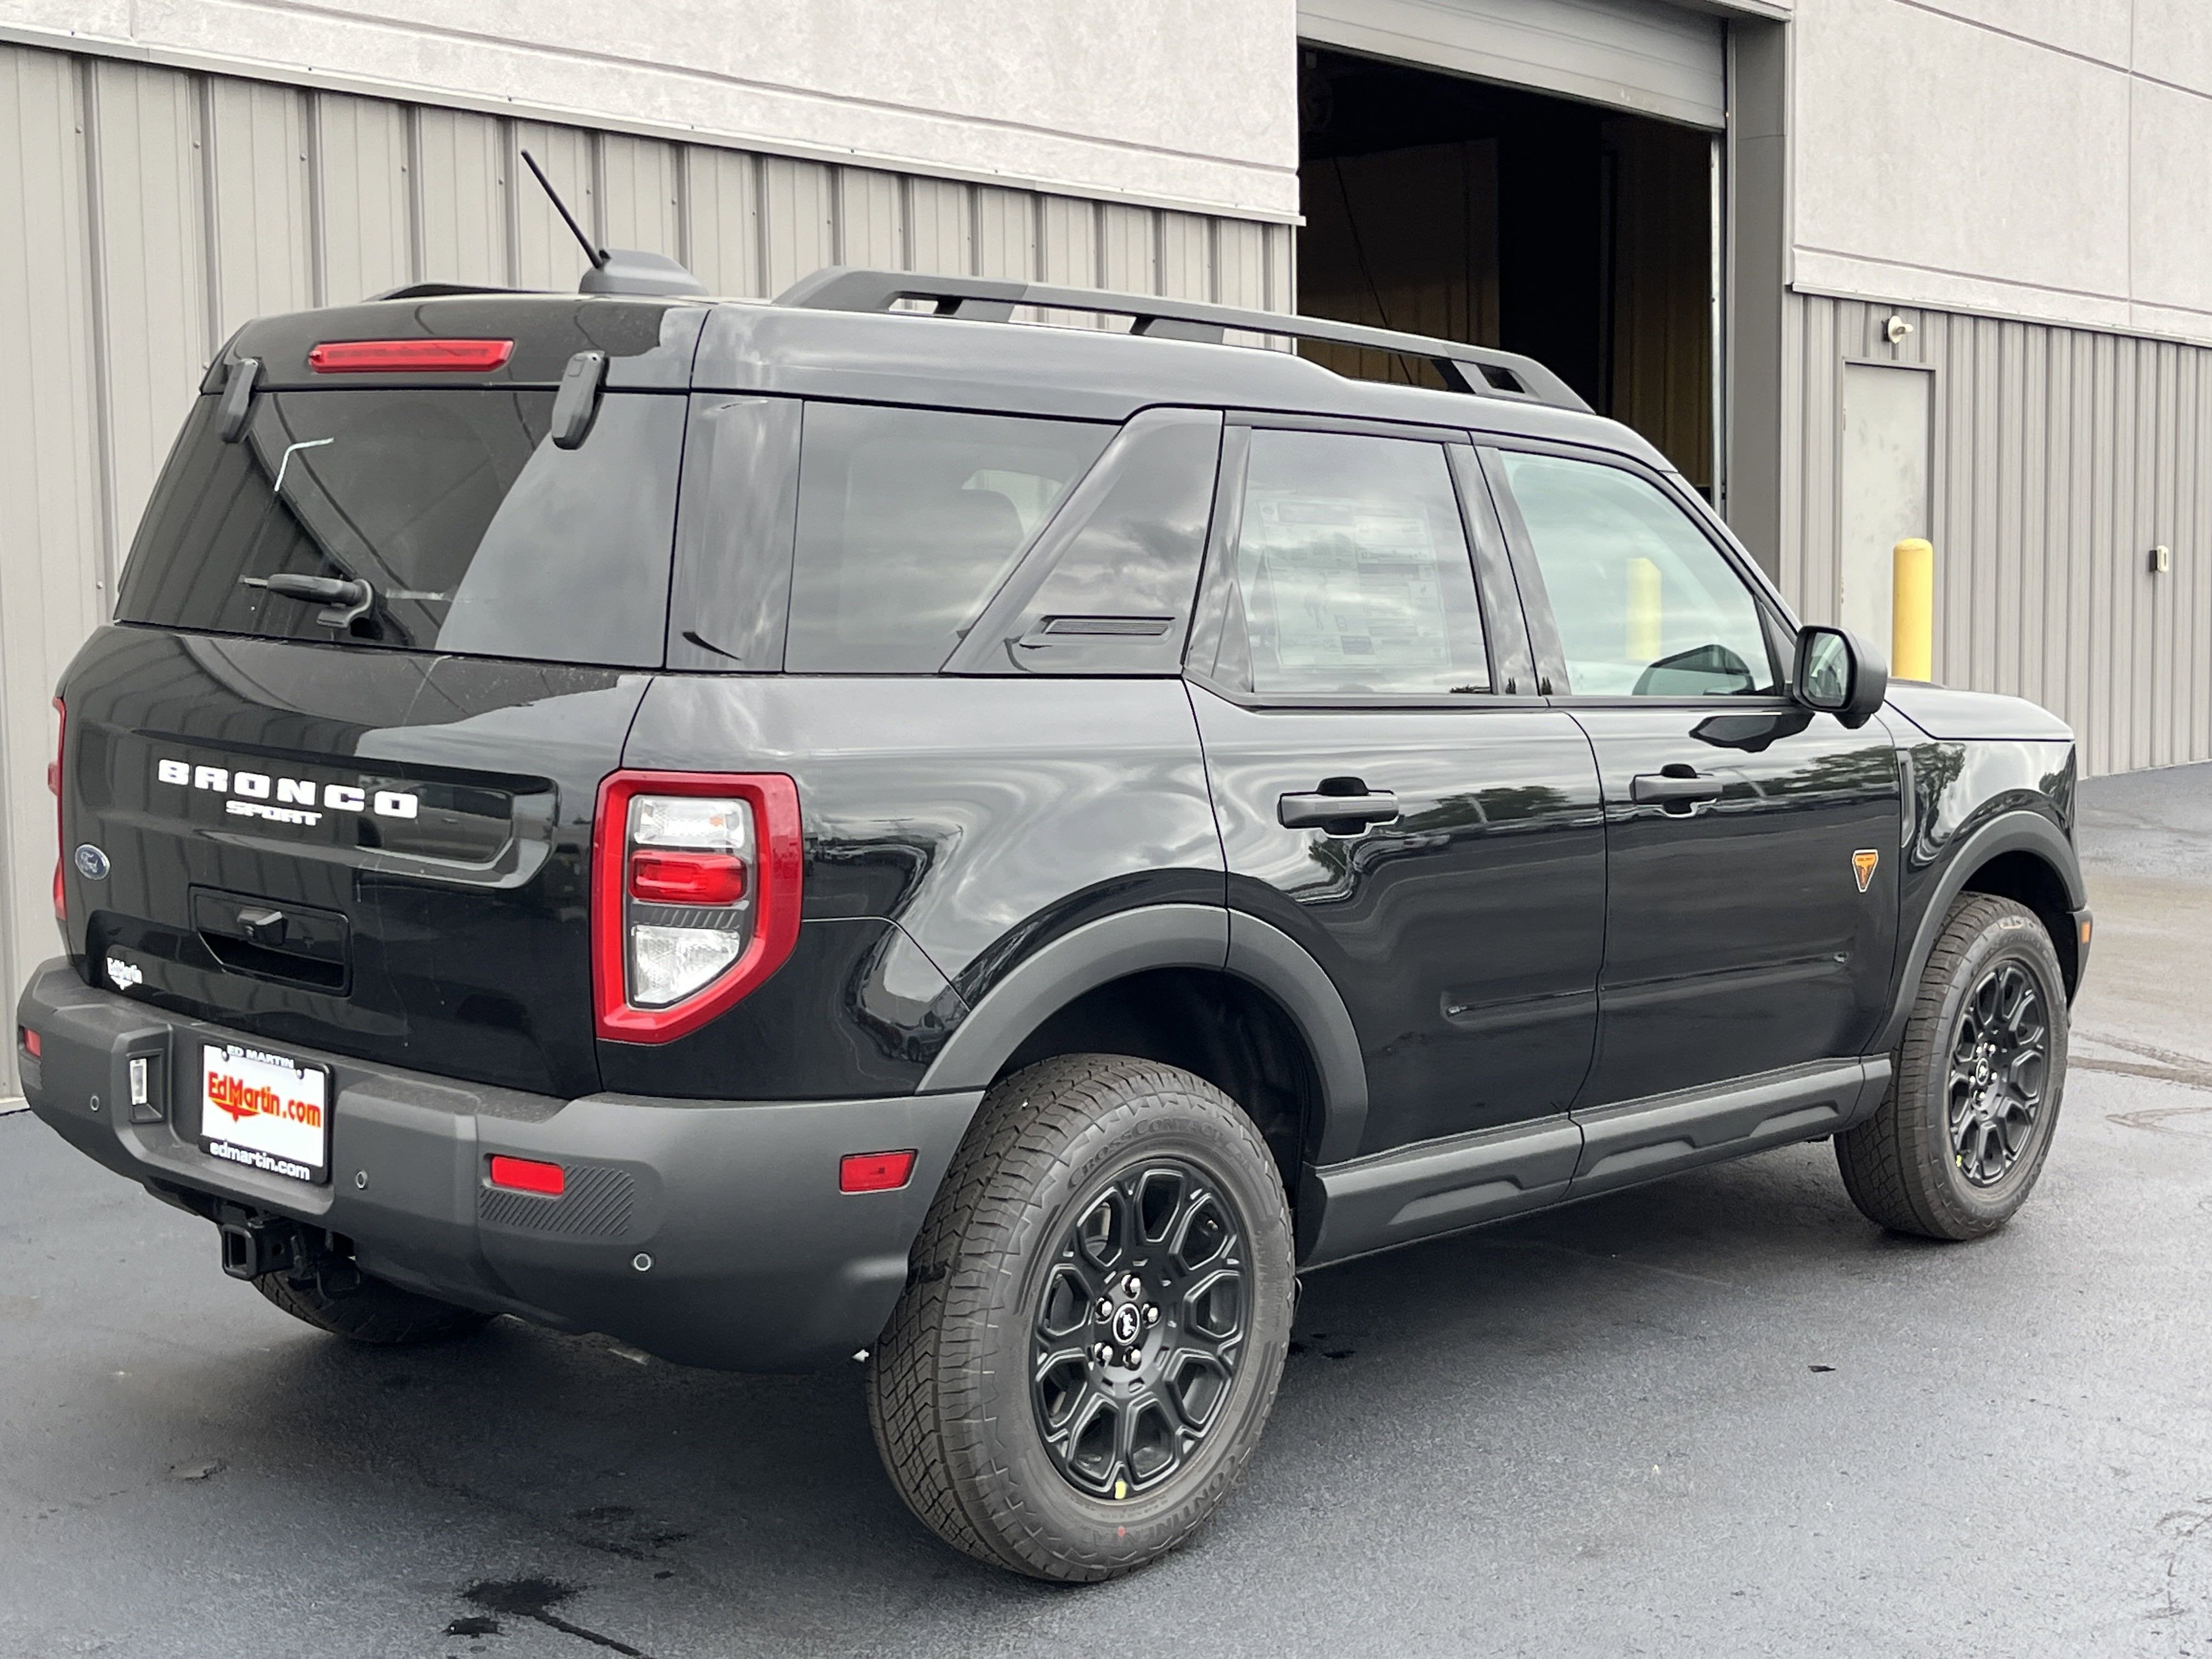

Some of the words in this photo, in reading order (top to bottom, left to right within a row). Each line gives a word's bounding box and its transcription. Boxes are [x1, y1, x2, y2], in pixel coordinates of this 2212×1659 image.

[158, 759, 417, 819] BRONCO
[225, 800, 322, 826] SPORT
[227, 1045, 244, 1057] ED
[246, 1049, 294, 1069] MARTIN
[208, 1071, 321, 1128] EdMartin.com
[210, 1140, 311, 1181] edmartin.com
